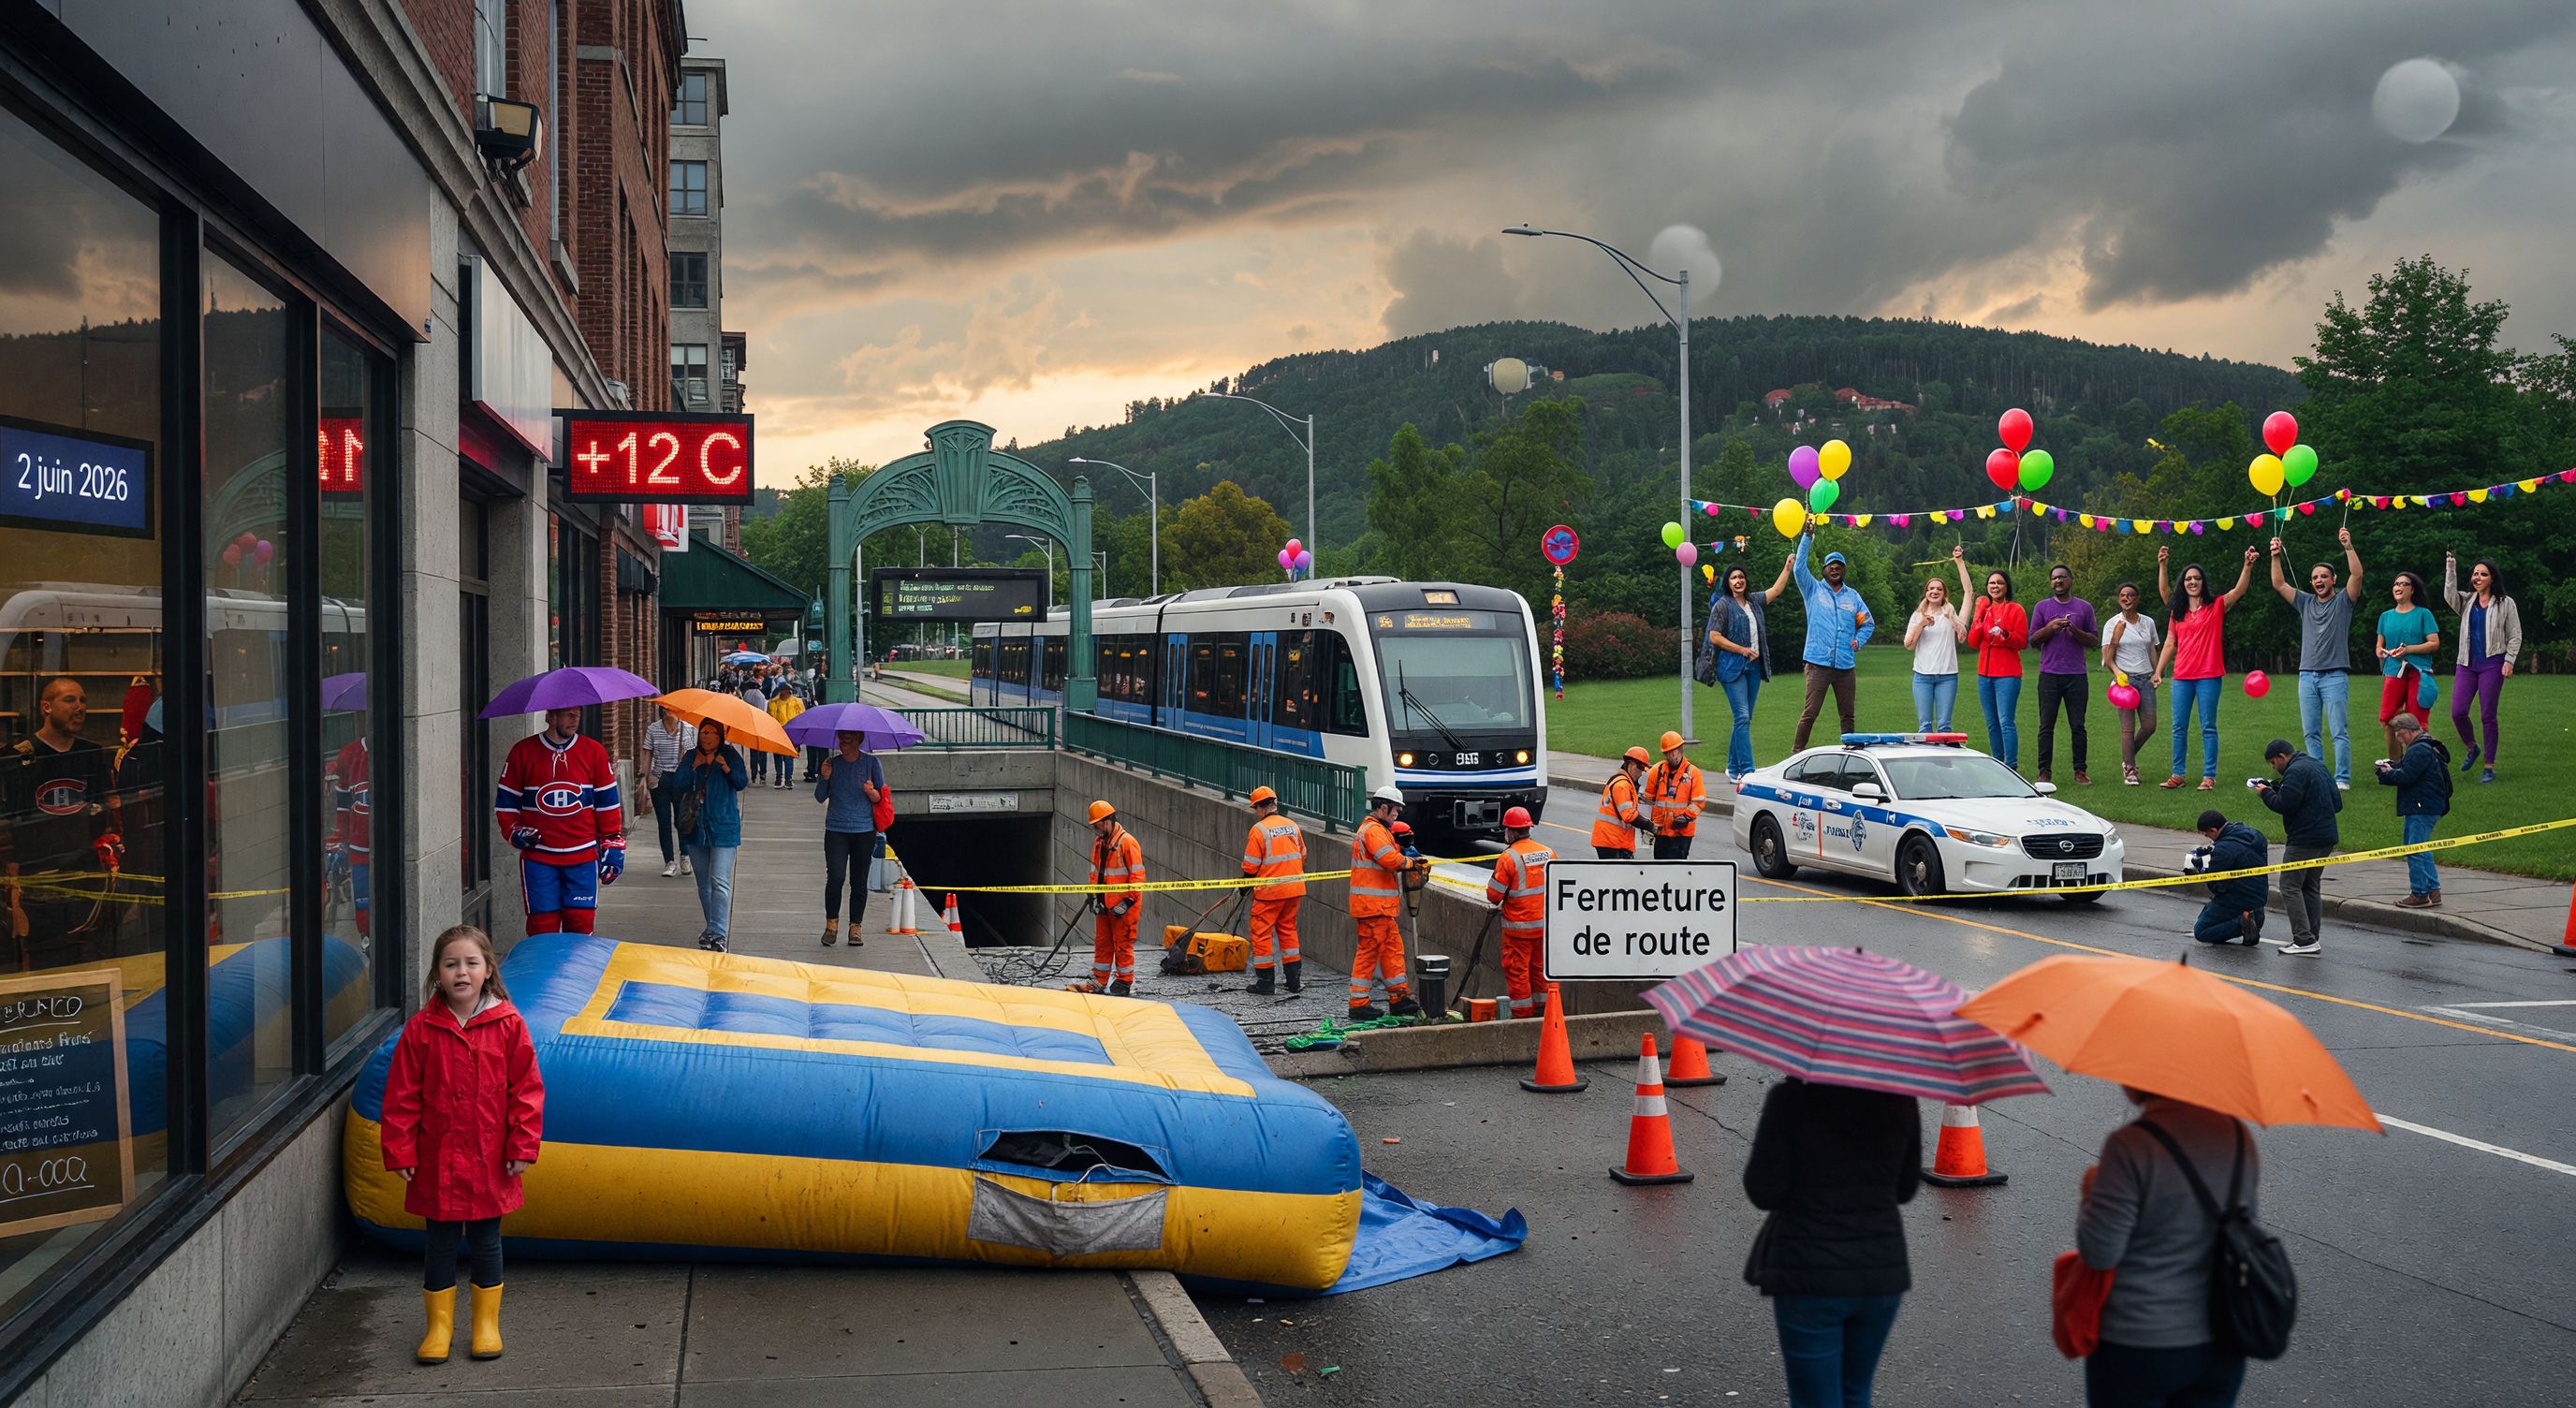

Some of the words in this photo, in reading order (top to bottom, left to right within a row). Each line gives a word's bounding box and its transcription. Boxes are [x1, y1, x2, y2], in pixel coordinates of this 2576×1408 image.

[17, 452, 32, 490] 2
[34, 455, 73, 501] juin
[79, 462, 129, 502] 2026
[577, 432, 680, 484] +12
[700, 432, 741, 485] C
[1558, 879, 1726, 913] Fermeture
[1573, 925, 1611, 955] de
[1625, 926, 1710, 955] route
